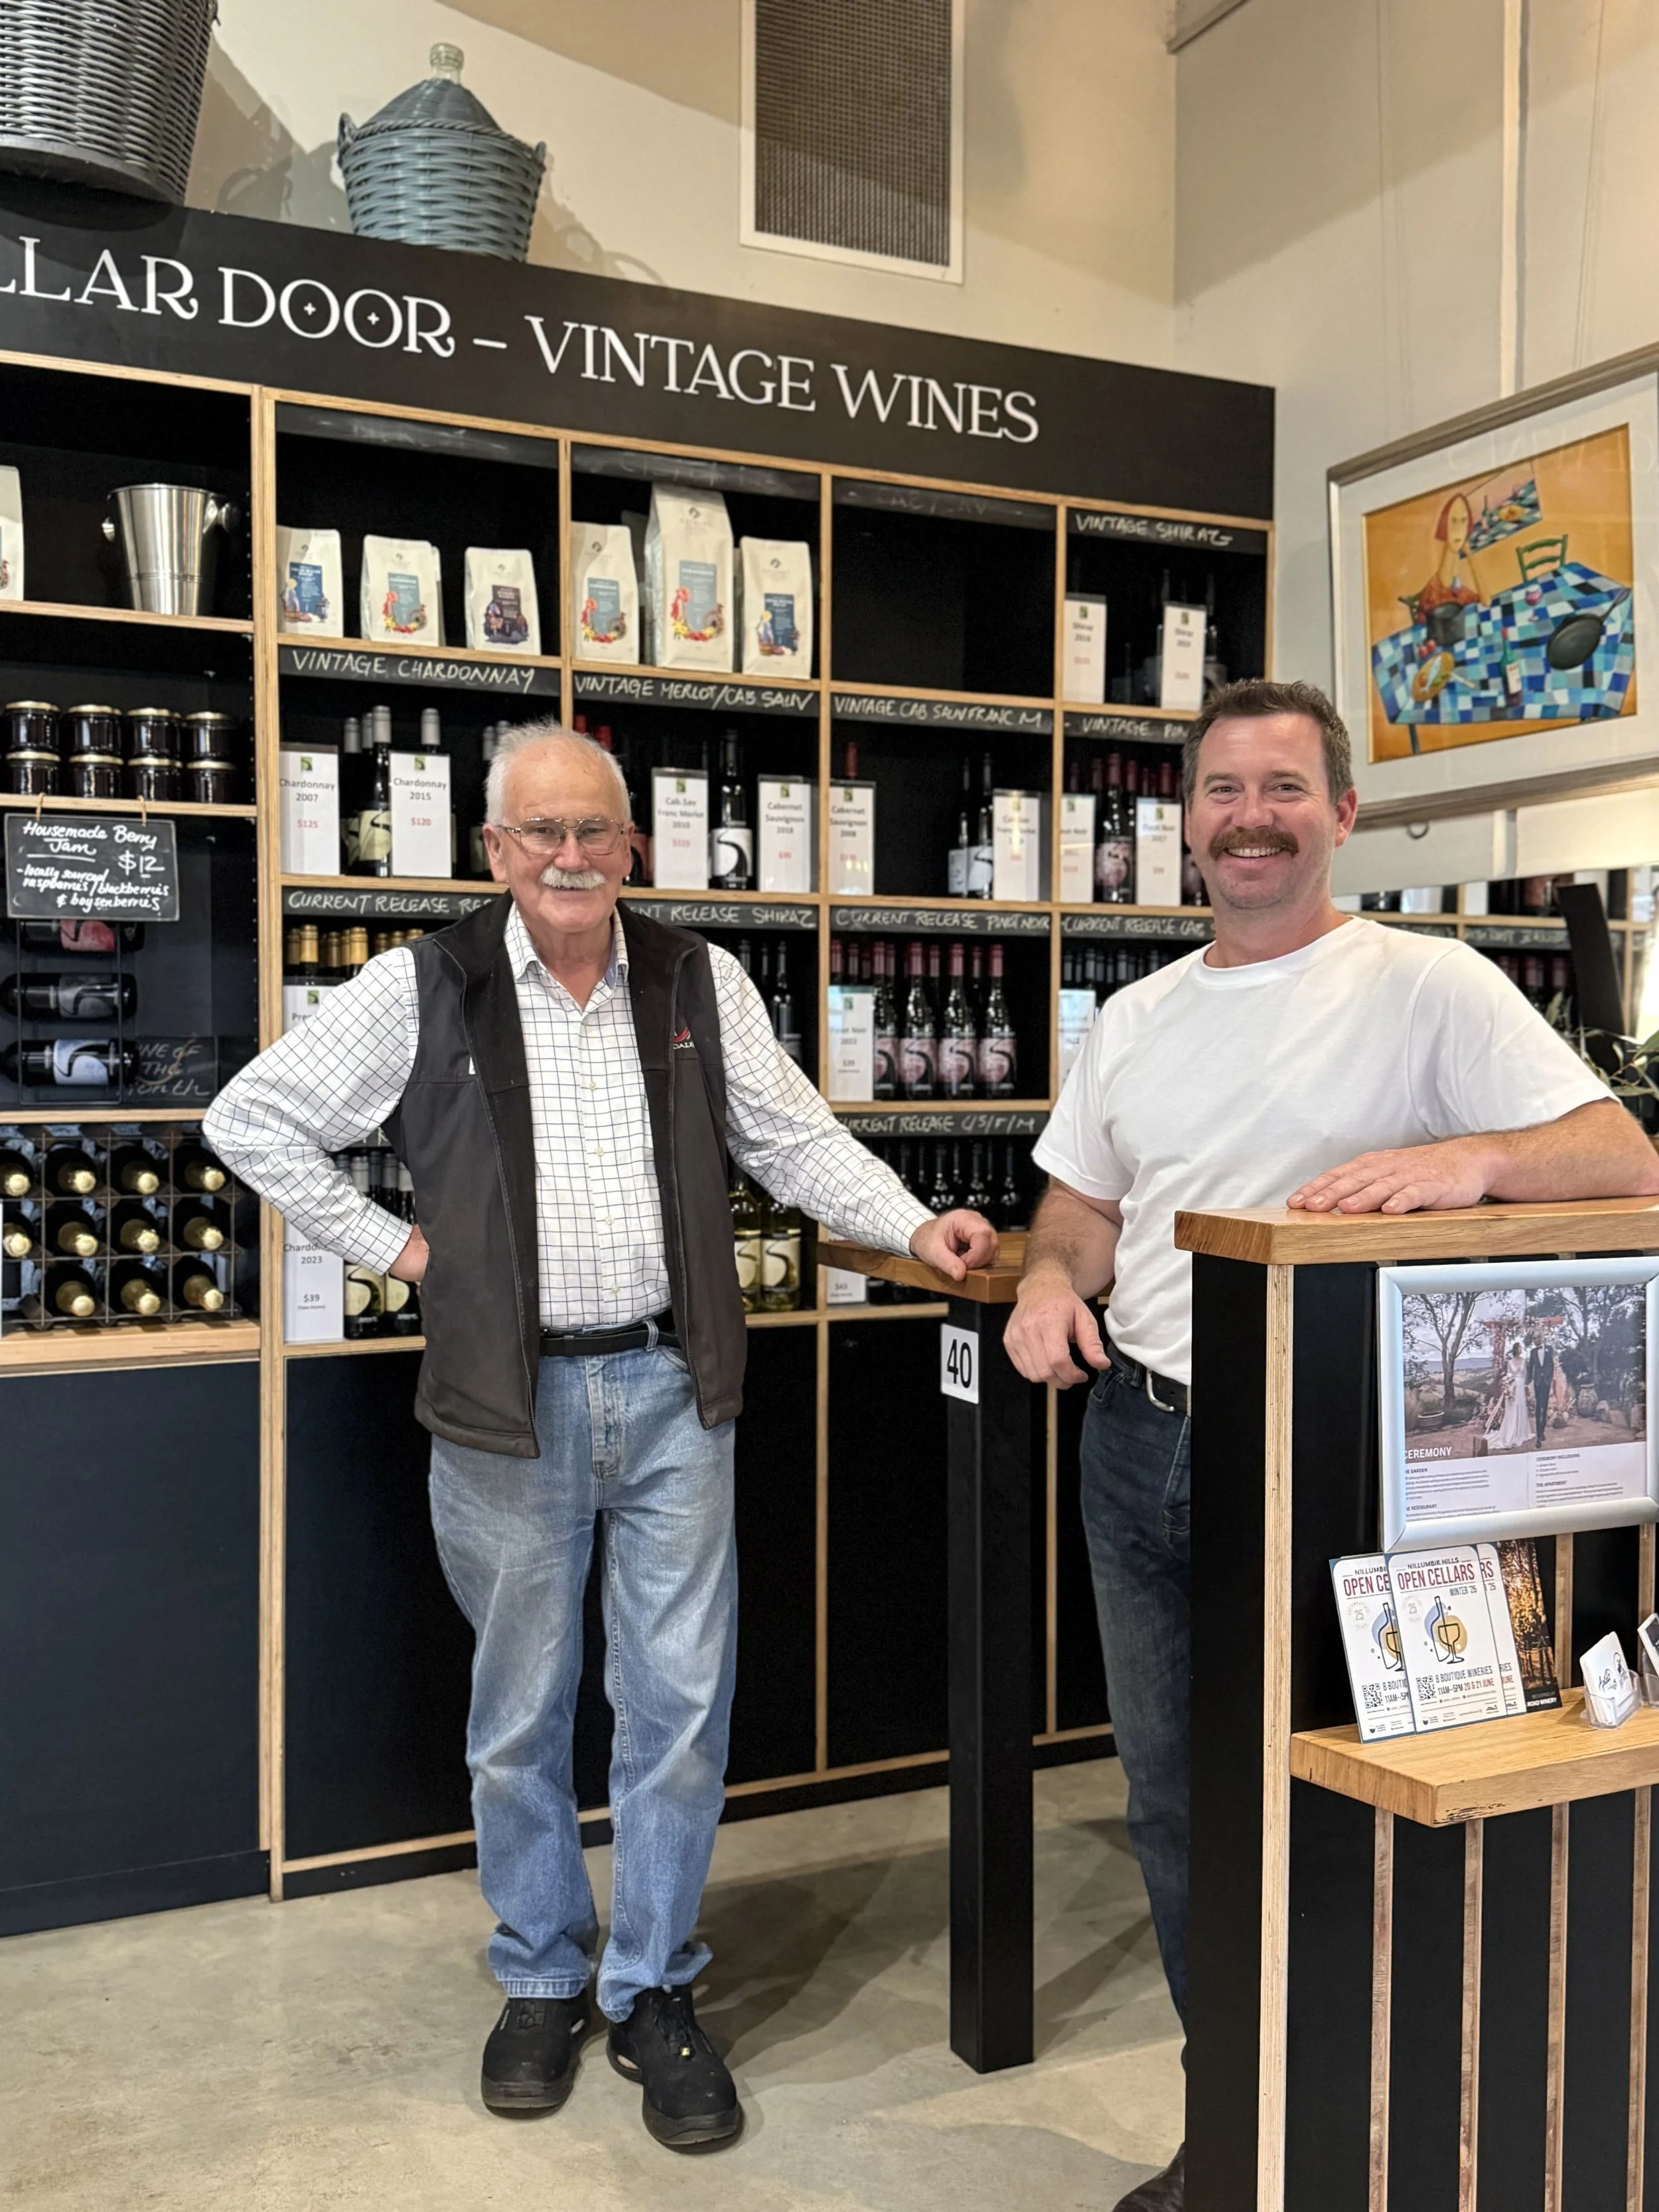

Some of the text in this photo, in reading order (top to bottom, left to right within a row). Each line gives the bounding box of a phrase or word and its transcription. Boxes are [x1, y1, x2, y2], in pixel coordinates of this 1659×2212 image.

[218, 267, 456, 358] DOOR
[524, 315, 816, 412] VINTAGE
[830, 364, 1040, 444] WINES
[1075, 514, 1234, 546] VINTAGE SHIRAZ
[291, 650, 535, 694] VINTAGE CHARDONNAY
[574, 675, 654, 697] VINTAGE
[762, 691, 814, 711] SAUV
[834, 696, 896, 717] VINTAGE
[899, 701, 928, 720] CAB
[1082, 717, 1151, 736] VINTAGE
[279, 778, 335, 791] Chardonnay
[393, 777, 447, 790] Chardonnay
[296, 793, 319, 802] 2007
[409, 792, 431, 800] 2015
[767, 802, 802, 810] Cabernet
[831, 806, 865, 814] Cabernet
[297, 820, 319, 829] $125
[411, 817, 432, 826] $120
[765, 814, 806, 824] Sauvignon
[830, 817, 867, 828] Sauvignon
[22, 821, 158, 851] Housemade Berry
[43, 838, 97, 855] Jam
[117, 849, 165, 878] $12
[61, 868, 109, 883] sourced
[288, 890, 372, 915] CURRENT
[375, 896, 450, 914] RELEASE
[670, 904, 741, 923] RELEASE
[751, 907, 817, 928] SHIRAZ
[835, 909, 910, 926] CURRENT
[914, 911, 979, 929] RELEASE
[985, 913, 1023, 931] PINOT
[1063, 916, 1122, 933] CURRENT
[1124, 917, 1175, 935] RELEASE
[899, 1115, 955, 1133] RELEASE
[301, 1256, 323, 1264] 2023
[303, 1293, 321, 1303] $39
[947, 1339, 972, 1388] 40
[1404, 1446, 1453, 1459] CEREMONY
[1407, 1557, 1460, 1570] NILLUMBIK HILLS
[1397, 1563, 1475, 1590] OPEN CELLARS
[1343, 1576, 1374, 1597] OPEN
[1449, 1587, 1468, 1597] WINTER
[1354, 1609, 1364, 1621] 25
[1435, 1665, 1493, 1683] 8 BOUTIQUE WINERIES
[1464, 1682, 1471, 1691] 20
[1476, 1680, 1482, 1689] 21
[1482, 1678, 1495, 1687] JUNE
